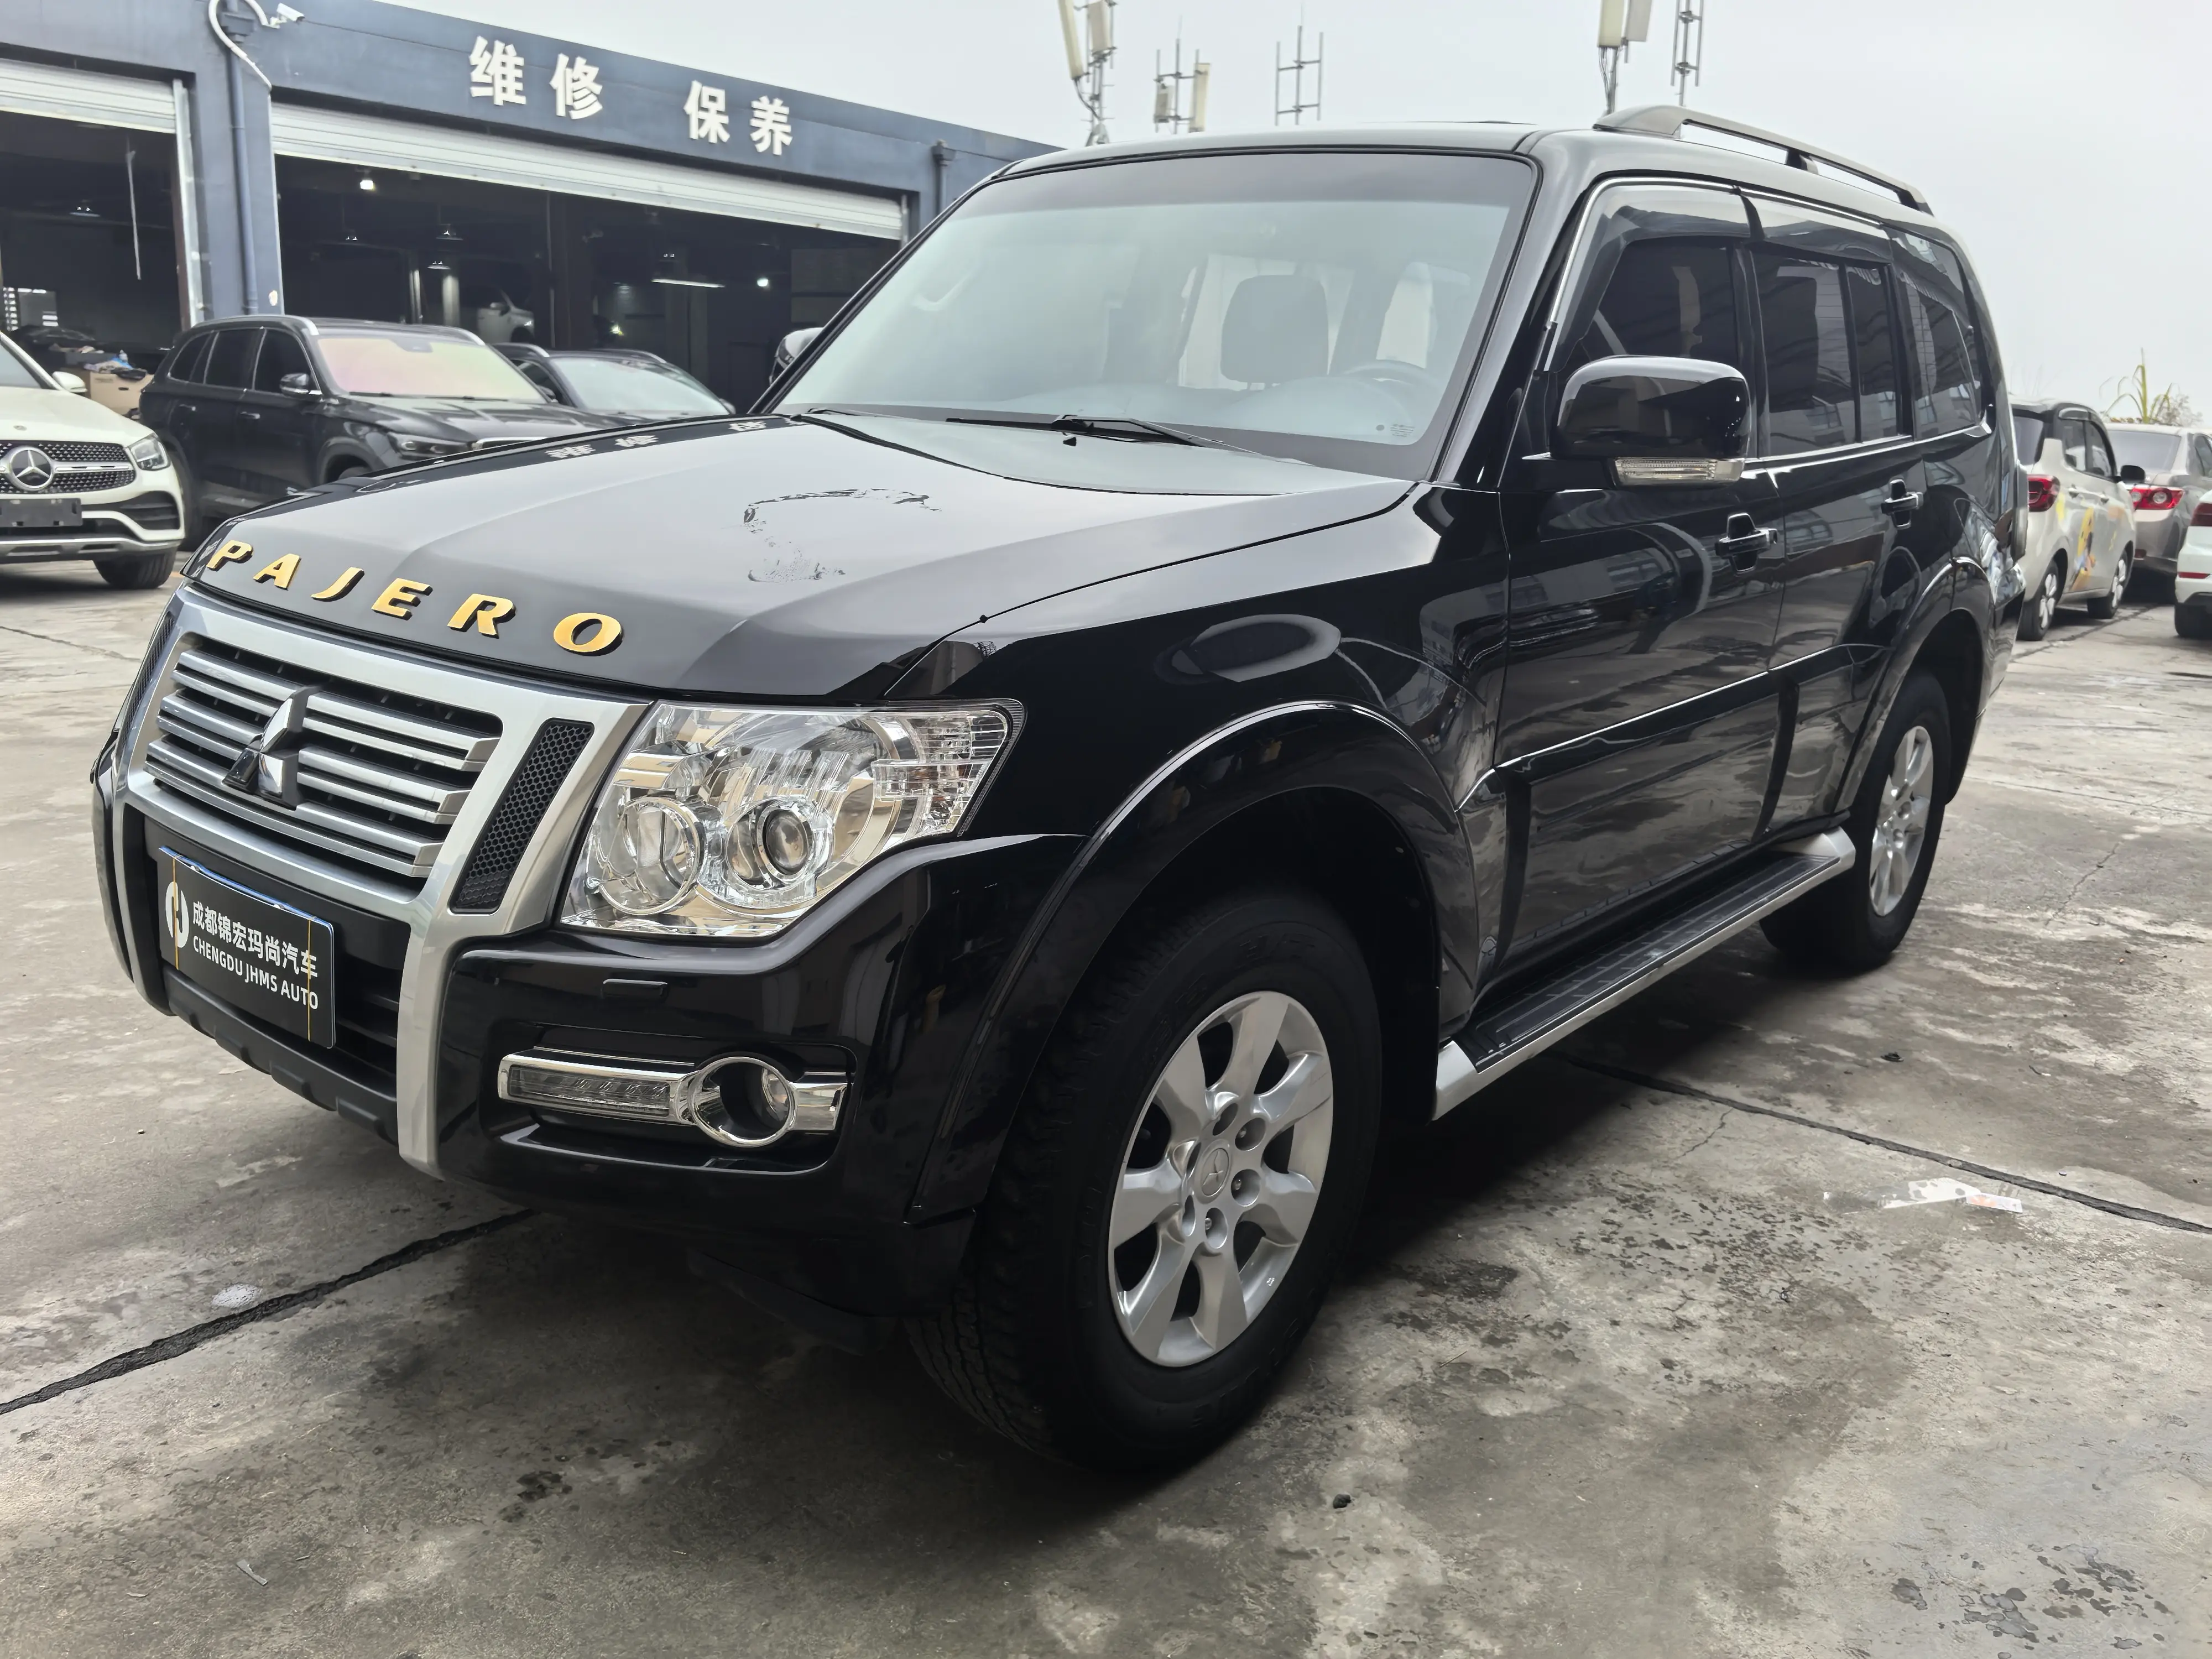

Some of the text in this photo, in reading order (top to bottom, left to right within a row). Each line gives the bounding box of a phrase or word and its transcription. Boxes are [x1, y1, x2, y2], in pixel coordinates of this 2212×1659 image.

[469, 36, 793, 155] 维修 保养
[206, 540, 625, 657] PAJERO
[192, 901, 318, 979] 成都锦宏玛尚汽车
[193, 935, 319, 1010] CHENGDU JHMS AUTO
